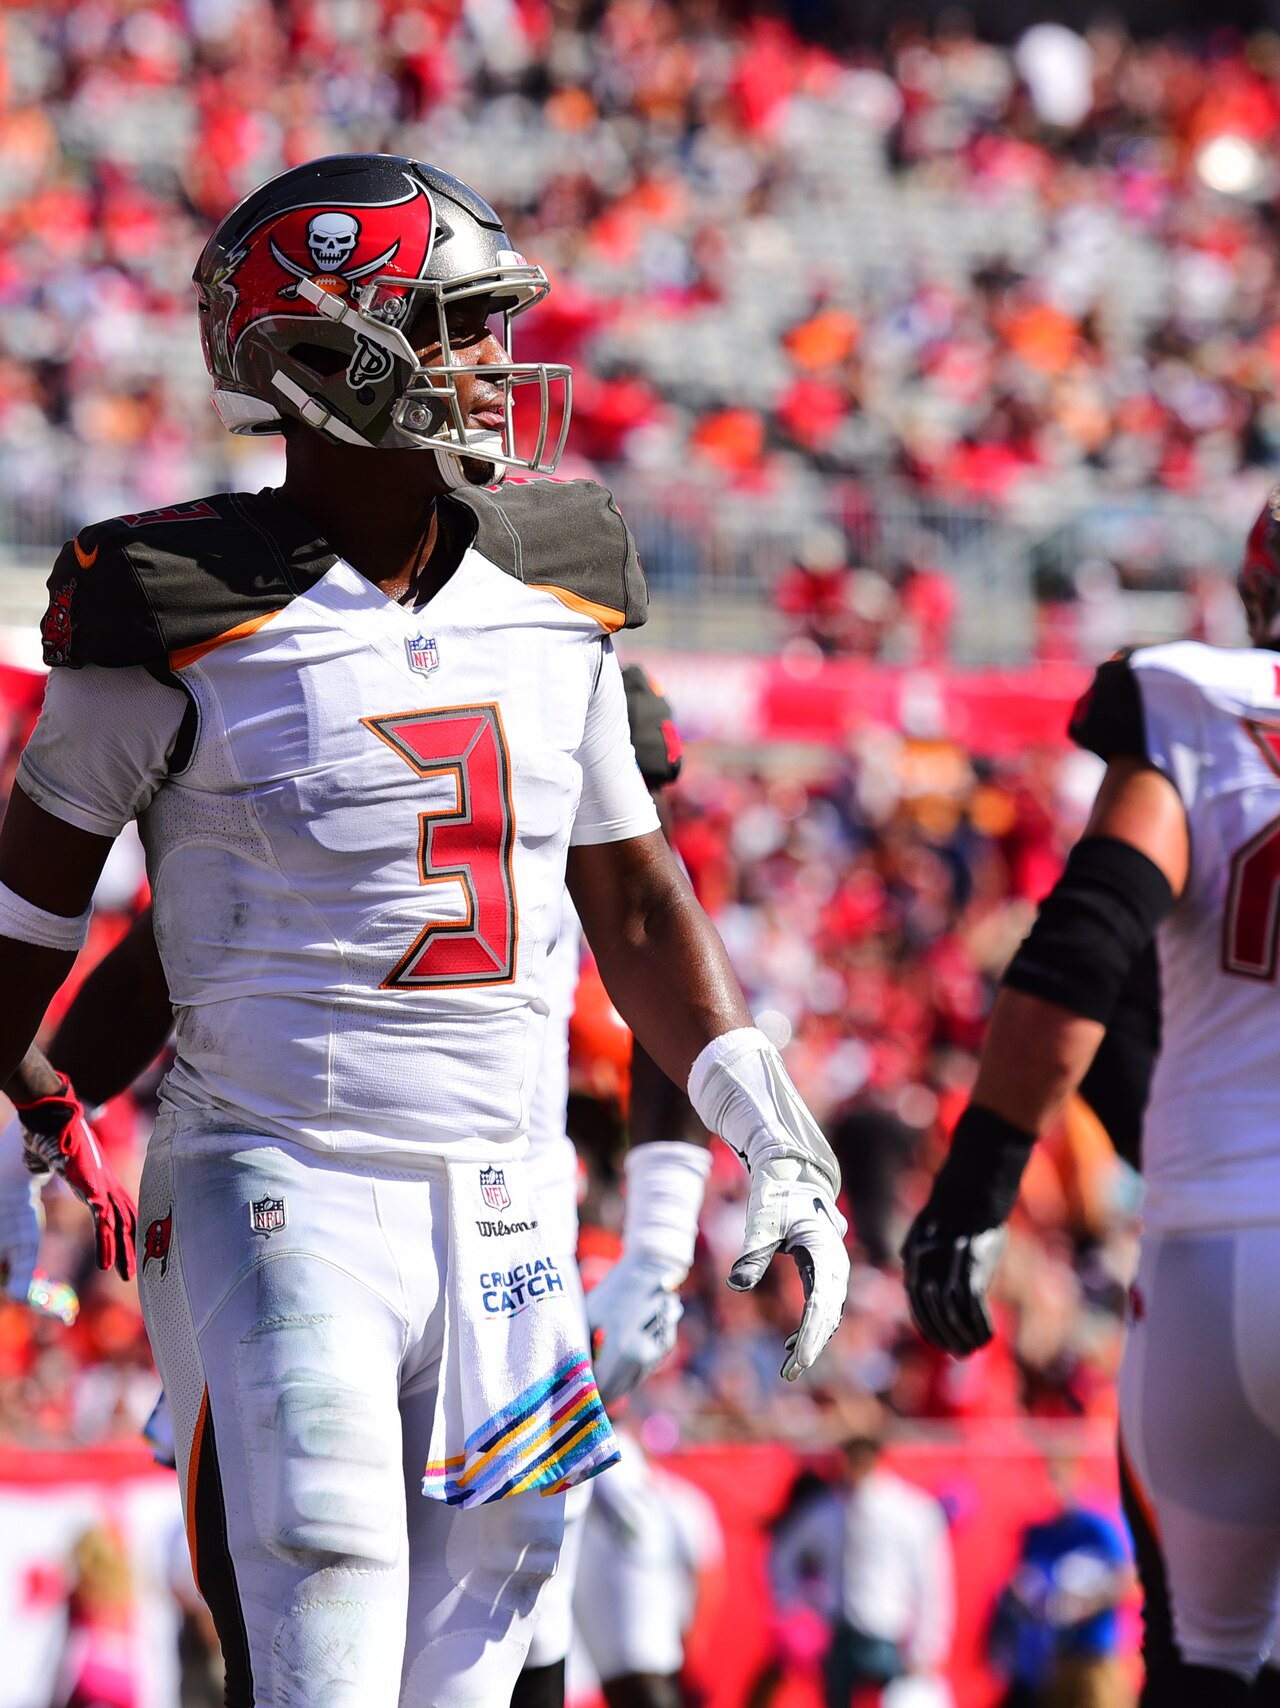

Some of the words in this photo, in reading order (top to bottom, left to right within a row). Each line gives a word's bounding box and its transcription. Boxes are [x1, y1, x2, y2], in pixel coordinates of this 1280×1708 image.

[412, 650, 438, 669] NFL
[361, 701, 519, 991] 3
[484, 1186, 508, 1207] NFL
[256, 1210, 282, 1229] NFL
[475, 1220, 531, 1237] Wilson
[480, 1257, 558, 1289] CRUCIAL
[482, 1273, 564, 1313] CATCH
